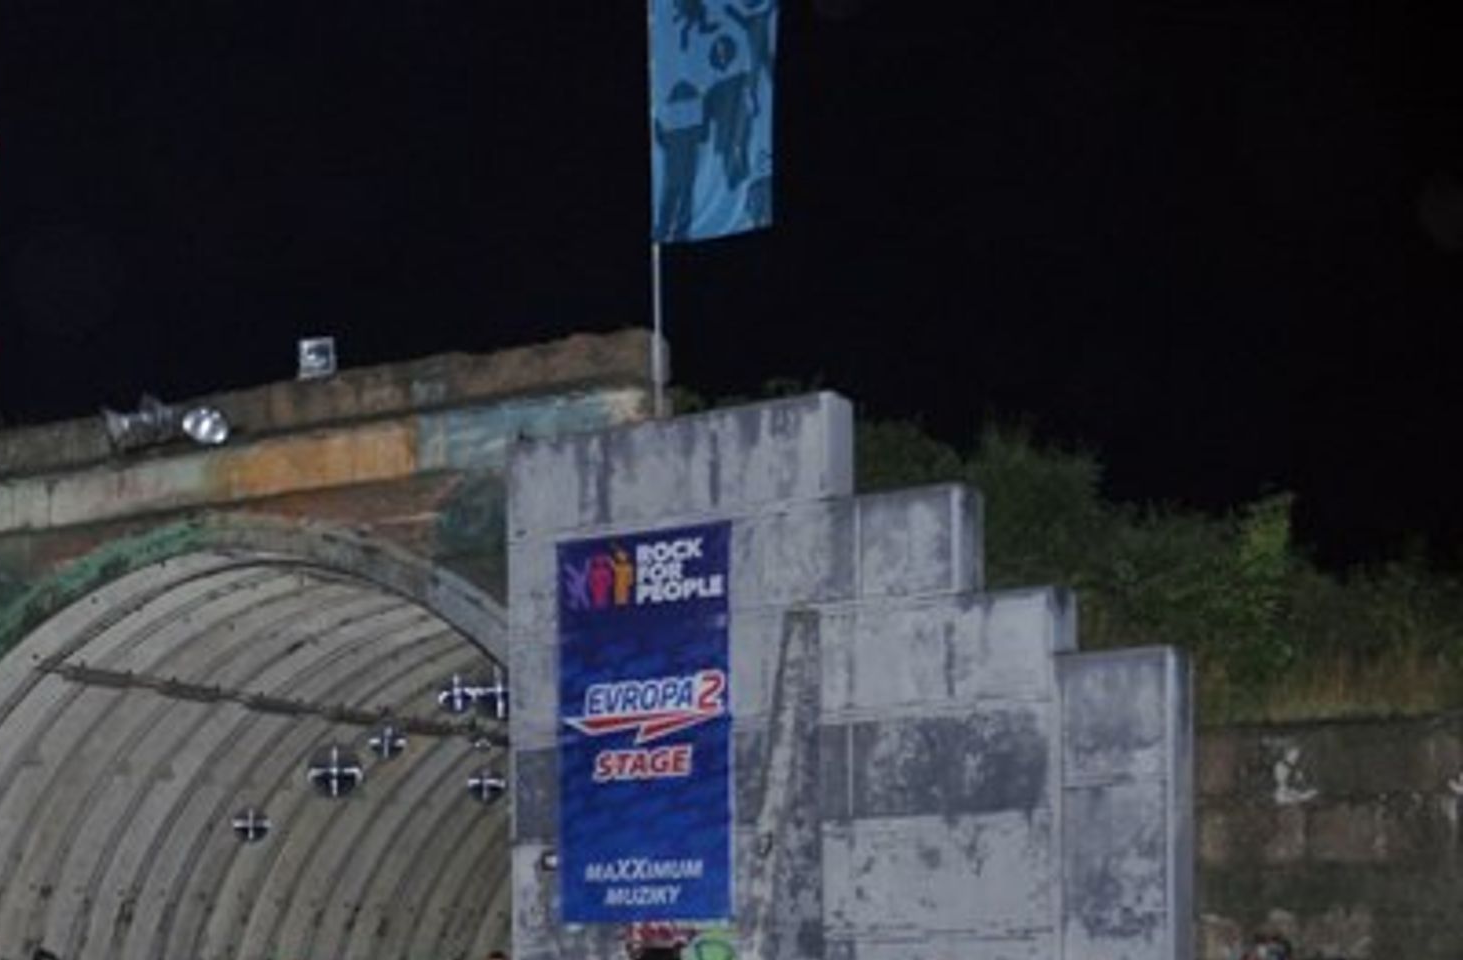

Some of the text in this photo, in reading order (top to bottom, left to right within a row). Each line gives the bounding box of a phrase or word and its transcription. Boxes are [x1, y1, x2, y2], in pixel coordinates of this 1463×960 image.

[636, 537, 703, 561] ROCK
[636, 561, 684, 585] FOR
[636, 574, 724, 605] PEOPLE
[594, 745, 692, 782] STAGE
